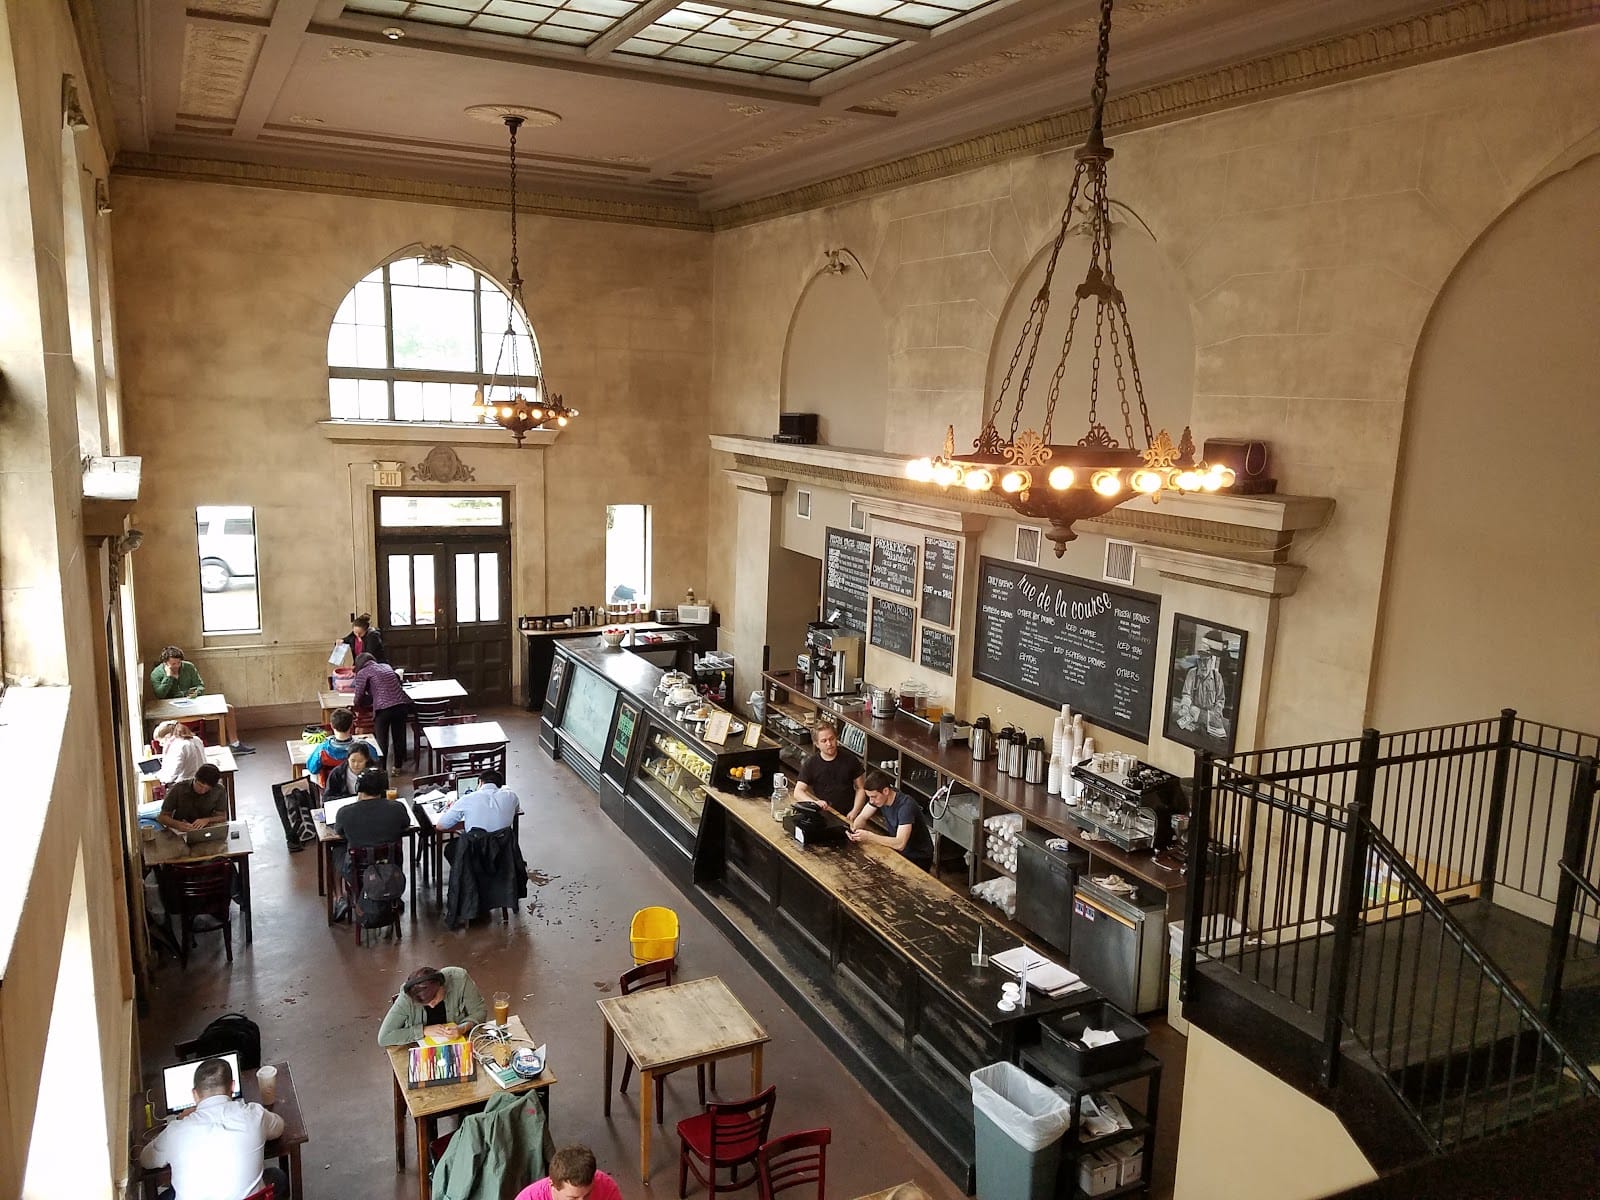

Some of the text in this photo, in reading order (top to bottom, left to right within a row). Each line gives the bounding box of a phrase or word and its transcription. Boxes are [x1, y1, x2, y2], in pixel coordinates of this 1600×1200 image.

[380, 472, 397, 485] EXIT
[1017, 574, 1112, 620] rue de la course
[1017, 608, 1032, 619] OTHER
[1065, 622, 1097, 638] ICED COFFEE
[1117, 640, 1131, 651] ICED
[1087, 656, 1106, 669] DRINKS
[1116, 667, 1140, 682] OTHERS
